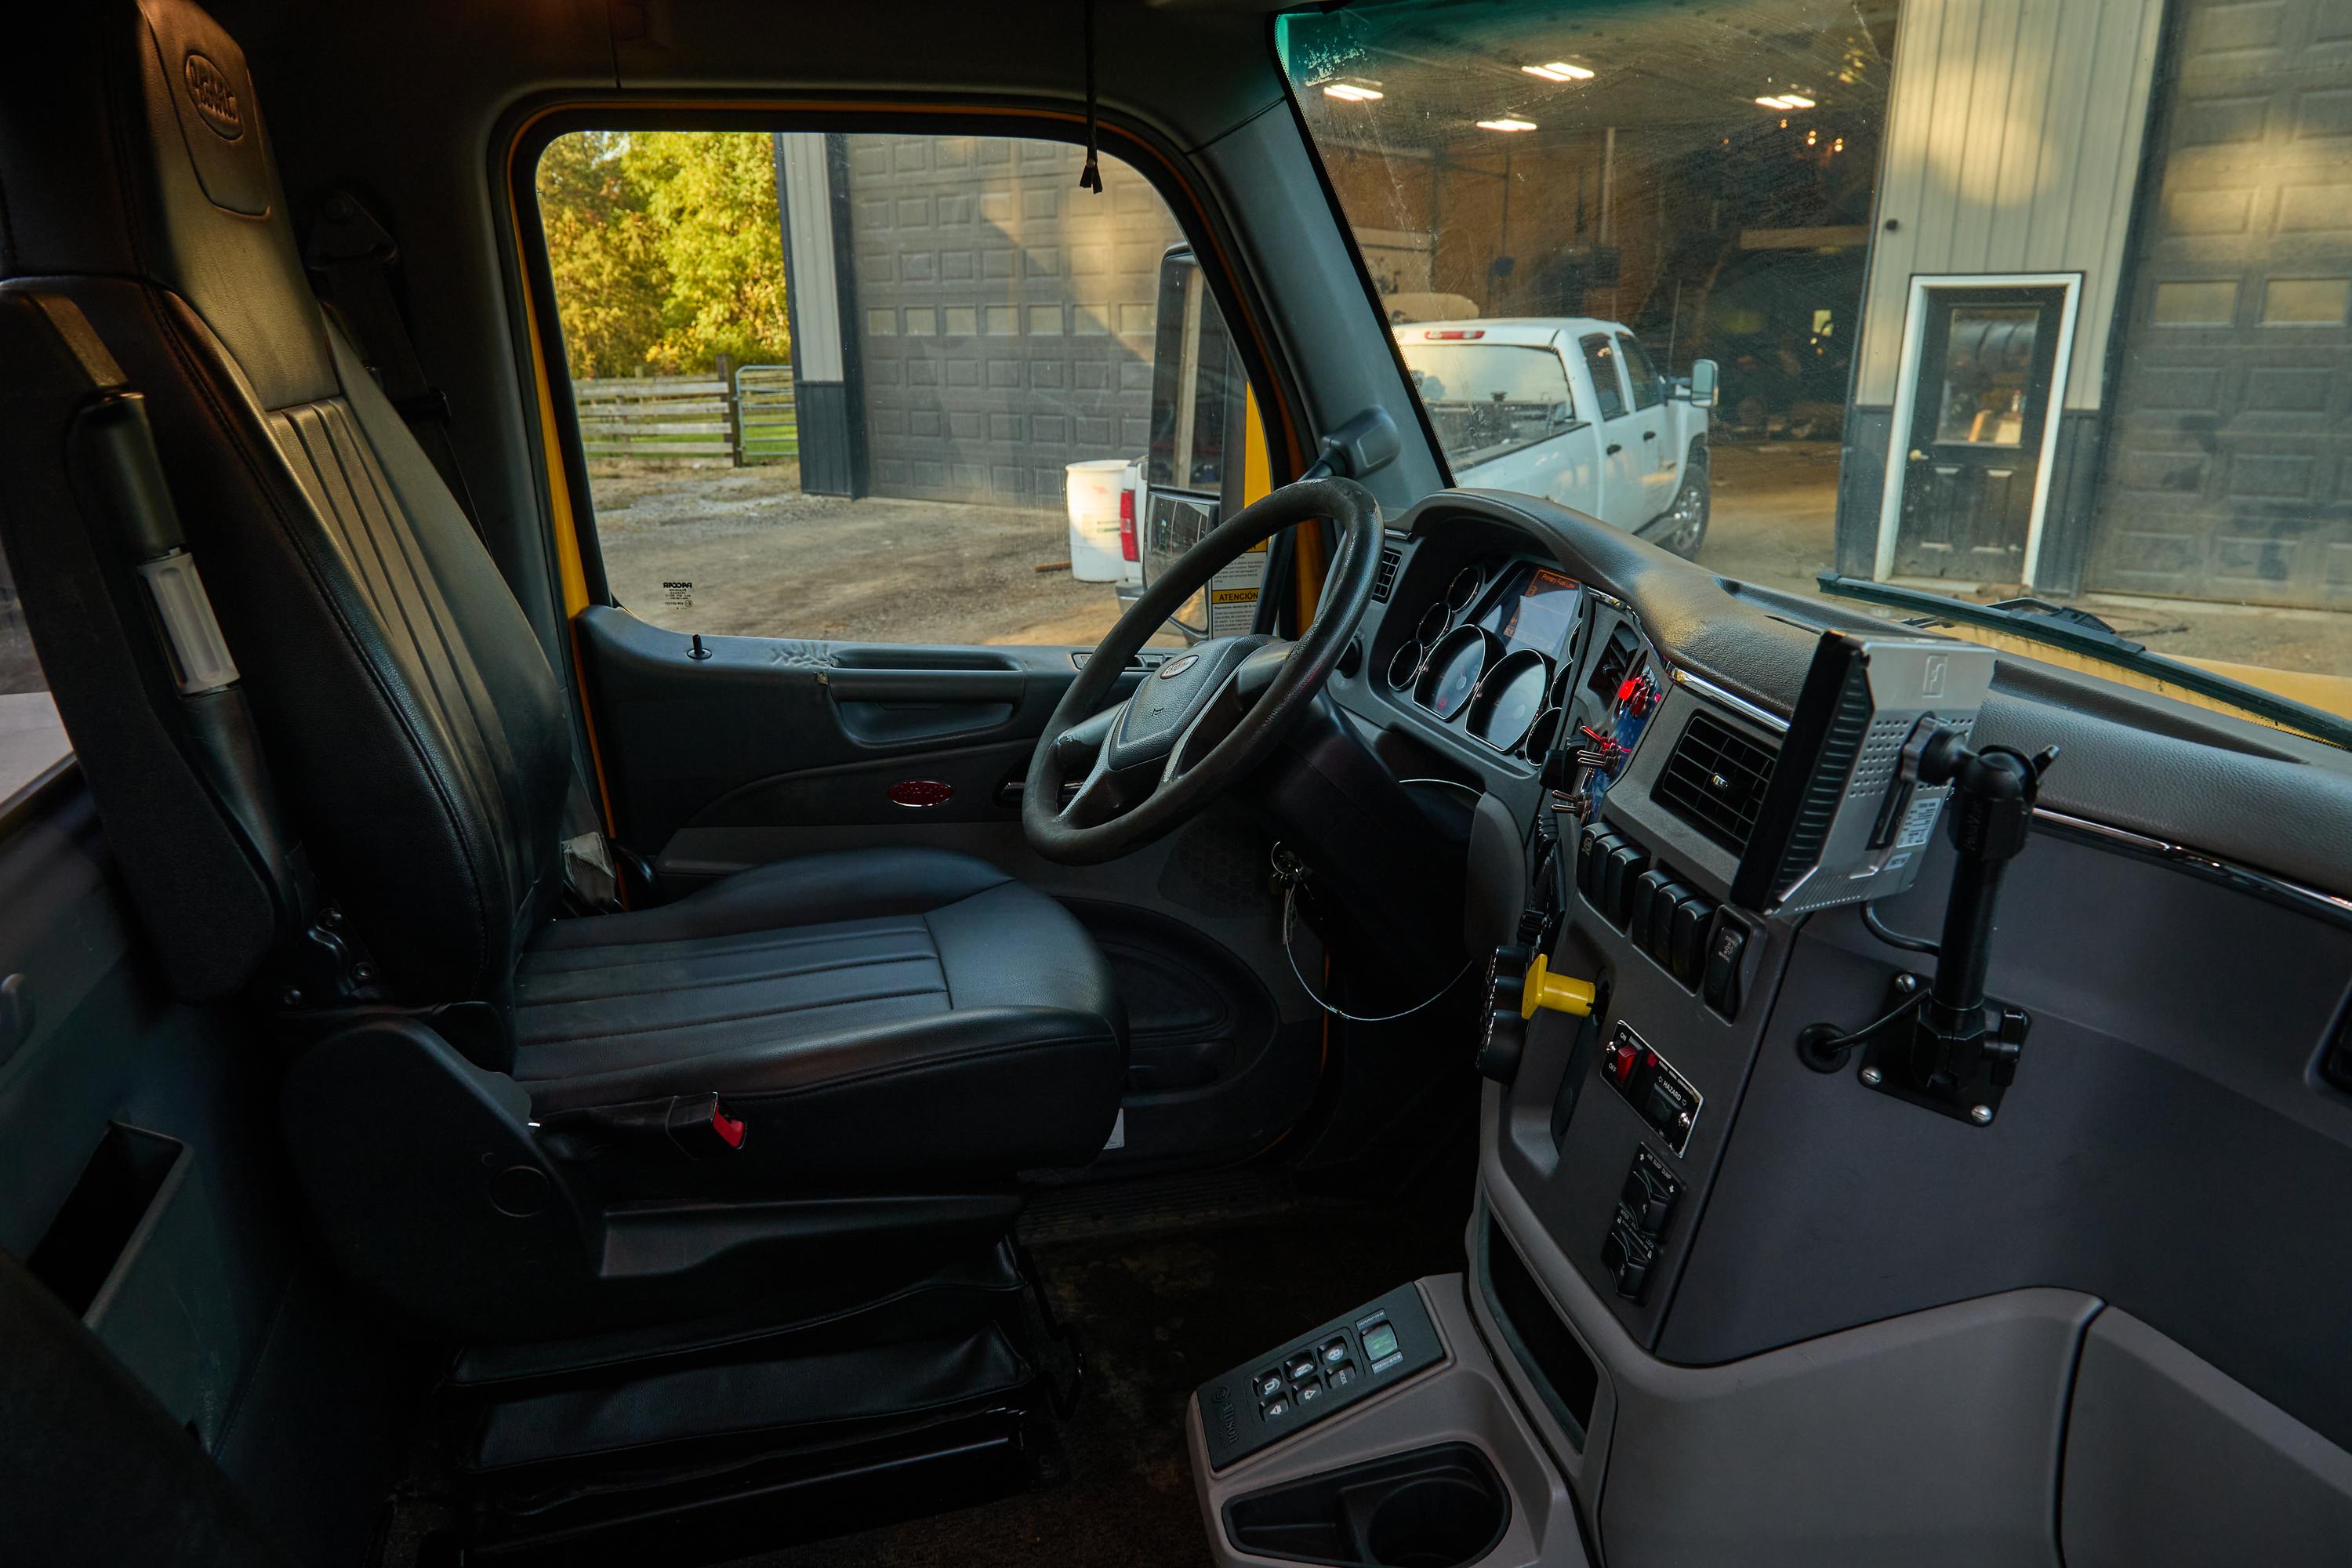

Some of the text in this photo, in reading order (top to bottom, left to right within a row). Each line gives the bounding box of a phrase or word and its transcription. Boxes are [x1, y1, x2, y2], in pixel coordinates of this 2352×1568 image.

[1219, 591, 1258, 601] ATENCIÓN
[1620, 1032, 1628, 1042] ON
[1663, 1080, 1682, 1102] HAZARD
[1338, 1370, 1348, 1386] MODE
